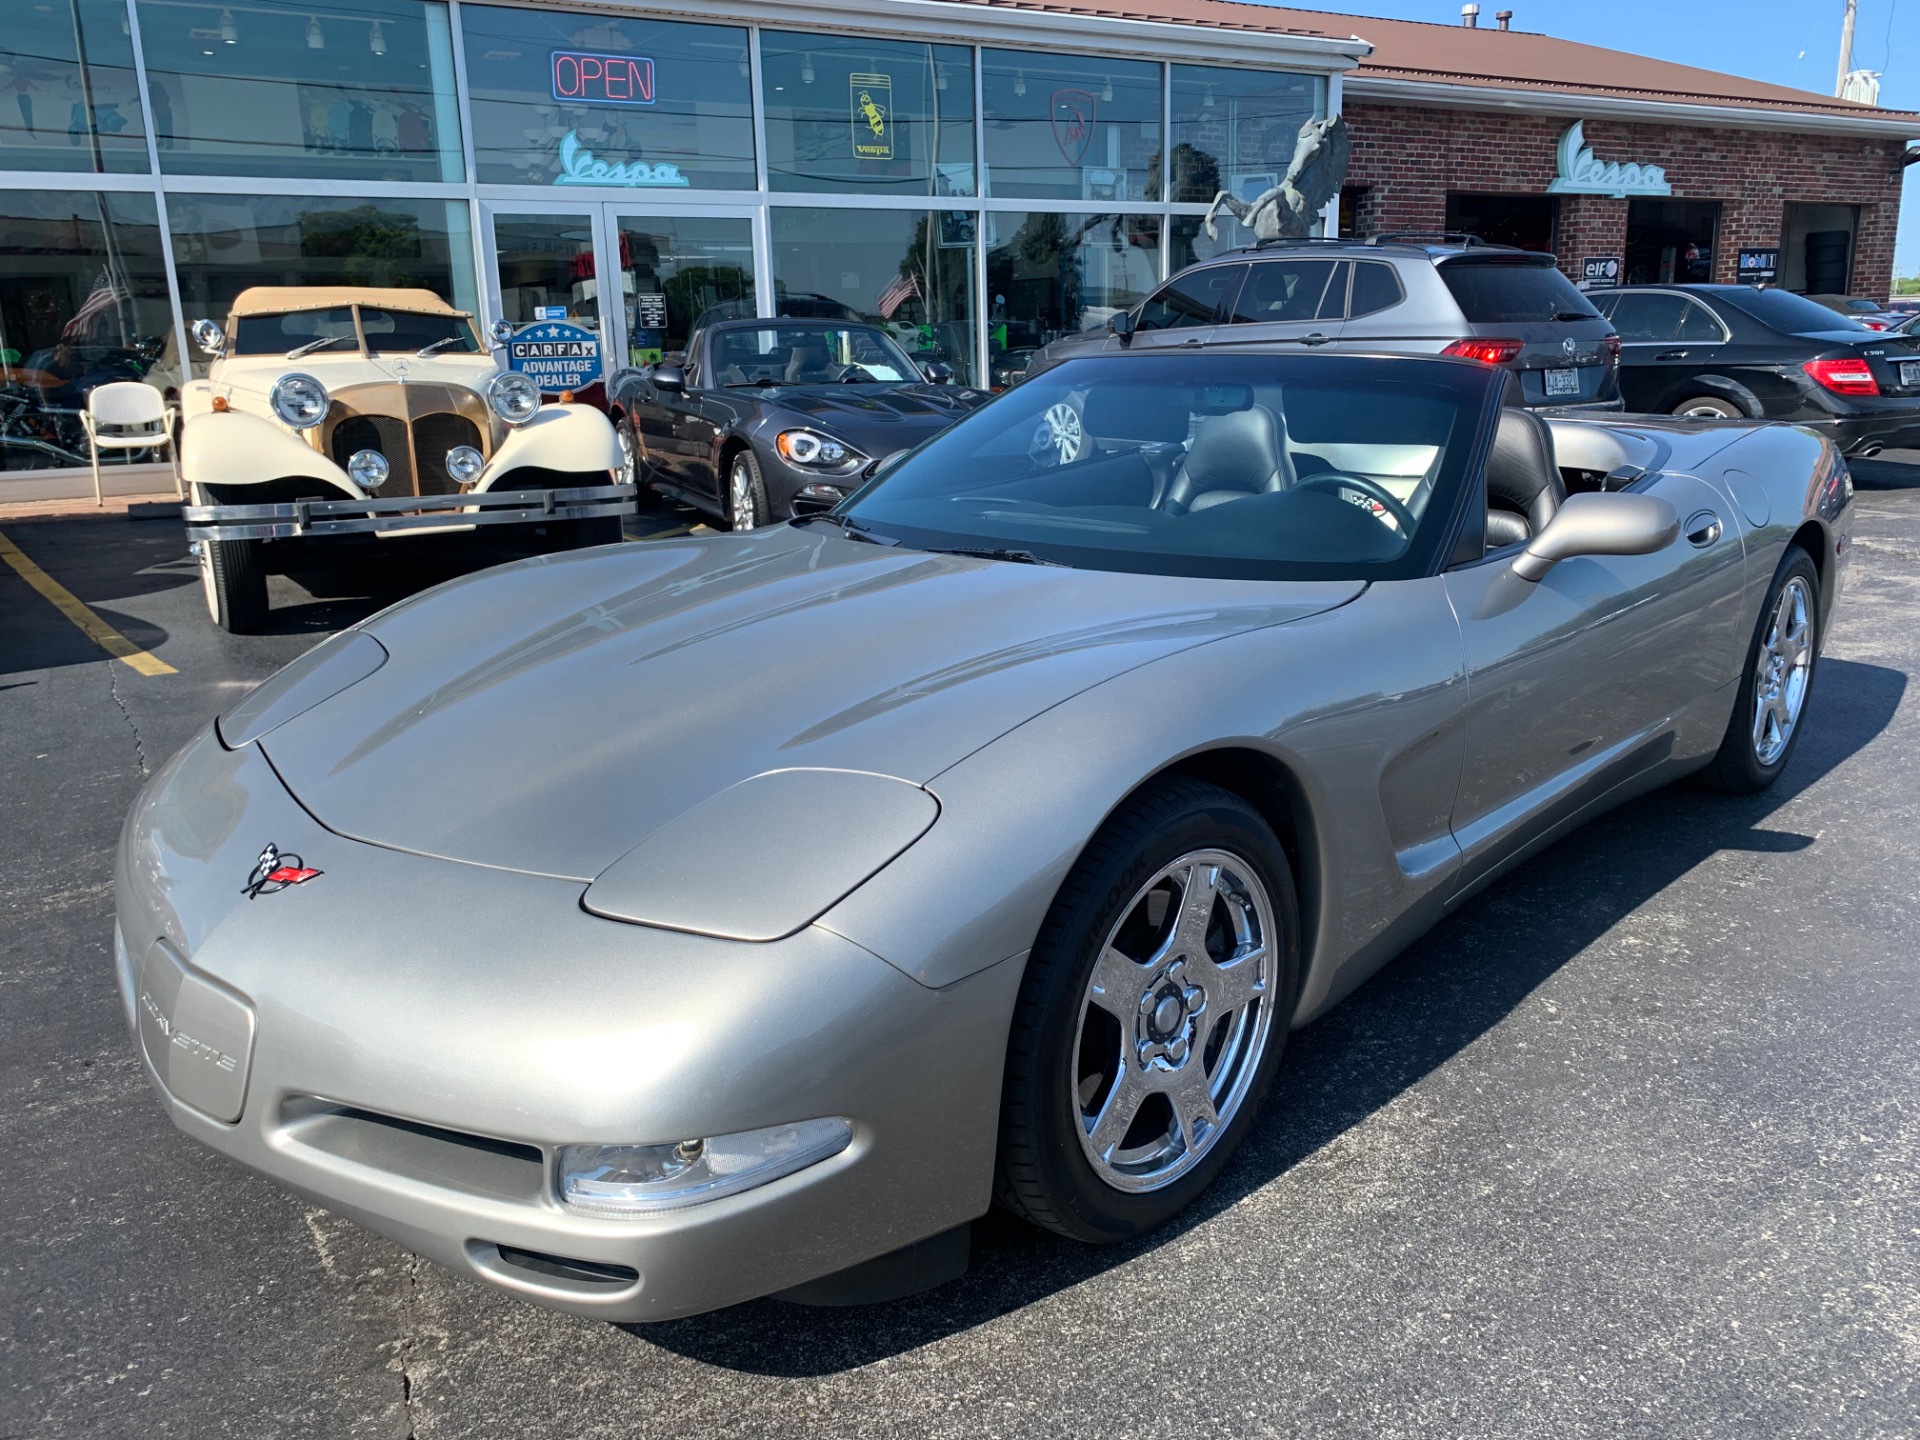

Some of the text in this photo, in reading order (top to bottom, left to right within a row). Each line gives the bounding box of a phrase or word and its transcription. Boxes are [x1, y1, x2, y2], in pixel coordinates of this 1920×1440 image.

[556, 57, 652, 99] OPEN
[556, 129, 686, 187] Vespa
[856, 145, 890, 156] Vespa
[1553, 119, 1670, 198] Vespa
[1739, 253, 1768, 269] Mobil
[1585, 262, 1607, 276] elf
[522, 360, 592, 374] ADVANTAGE
[535, 373, 582, 387] DEALER
